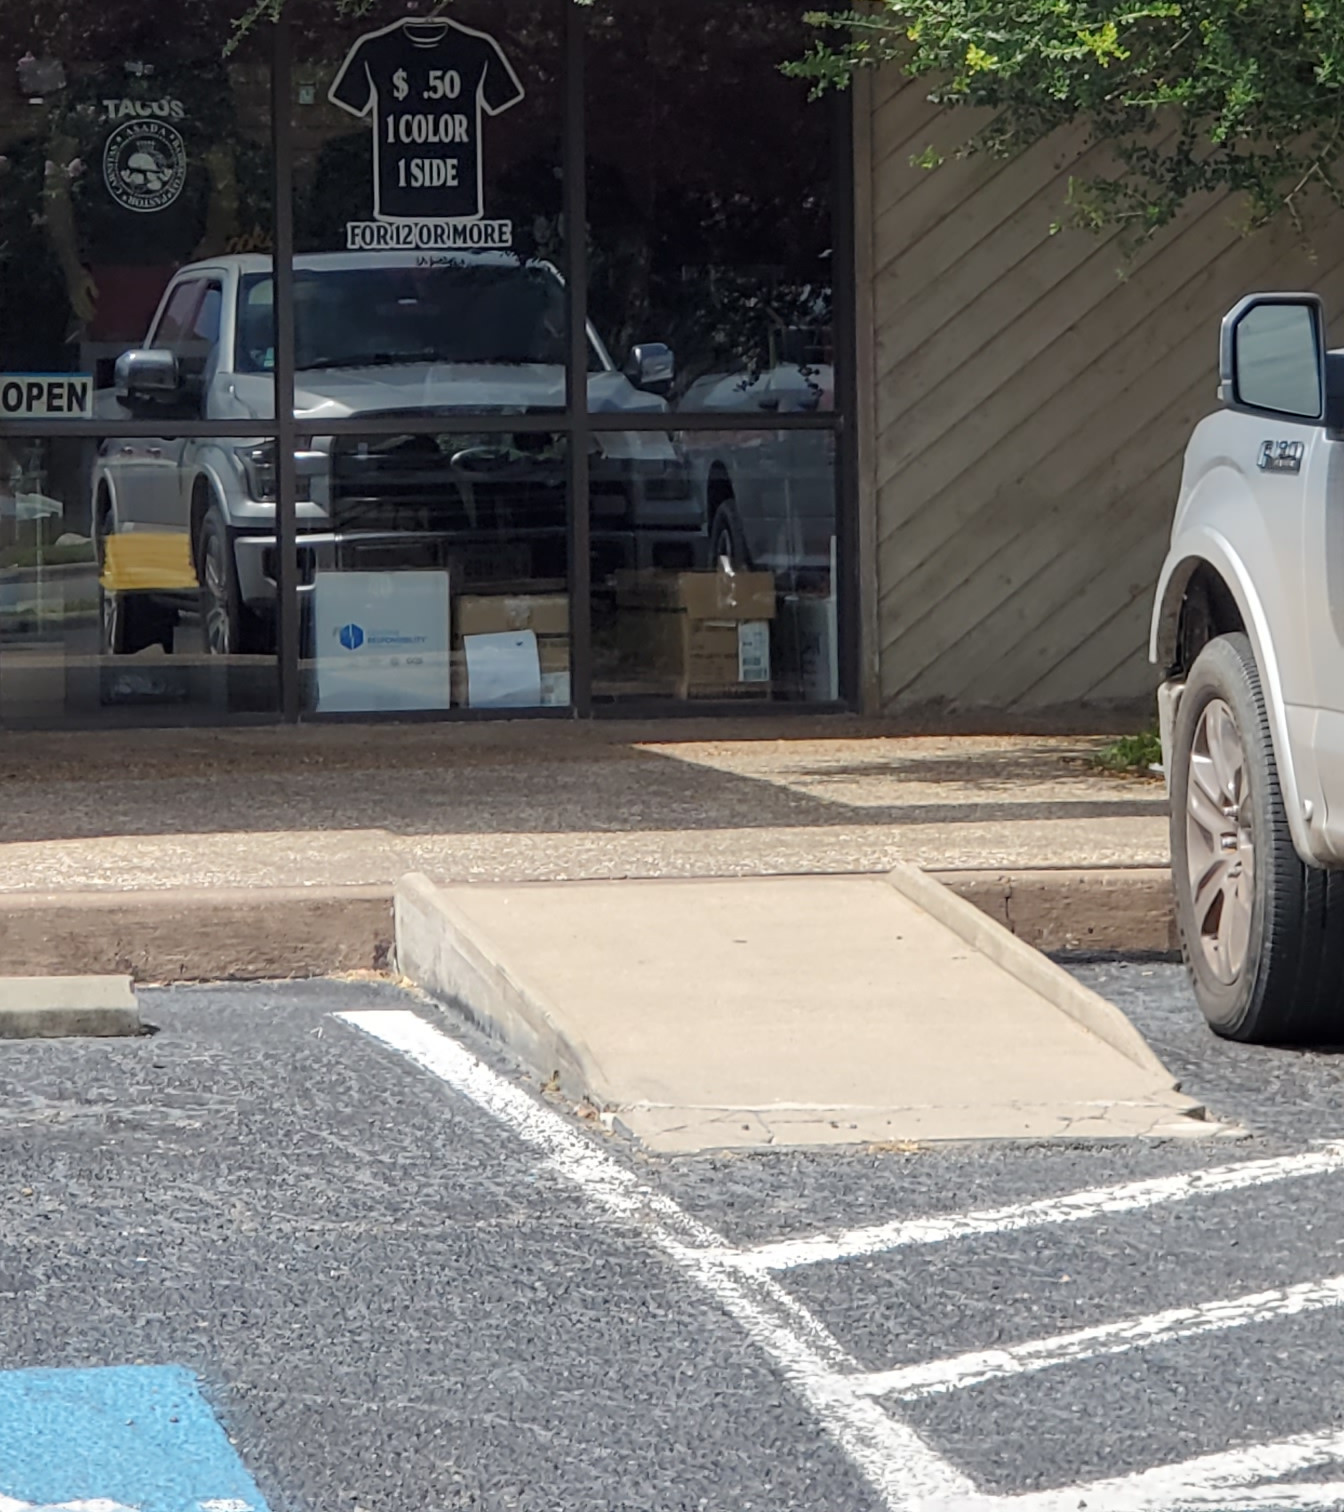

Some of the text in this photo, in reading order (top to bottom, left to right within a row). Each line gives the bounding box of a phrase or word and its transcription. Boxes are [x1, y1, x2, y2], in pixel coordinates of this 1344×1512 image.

[392, 68, 461, 101] $ .50
[102, 97, 185, 118] TACOS
[126, 123, 167, 136] ASADA
[386, 114, 469, 143] 1 COLOR
[398, 158, 459, 187] 1 SIDE
[349, 223, 510, 246] FOR 12 OR MORE
[2, 381, 88, 412] OPEN
